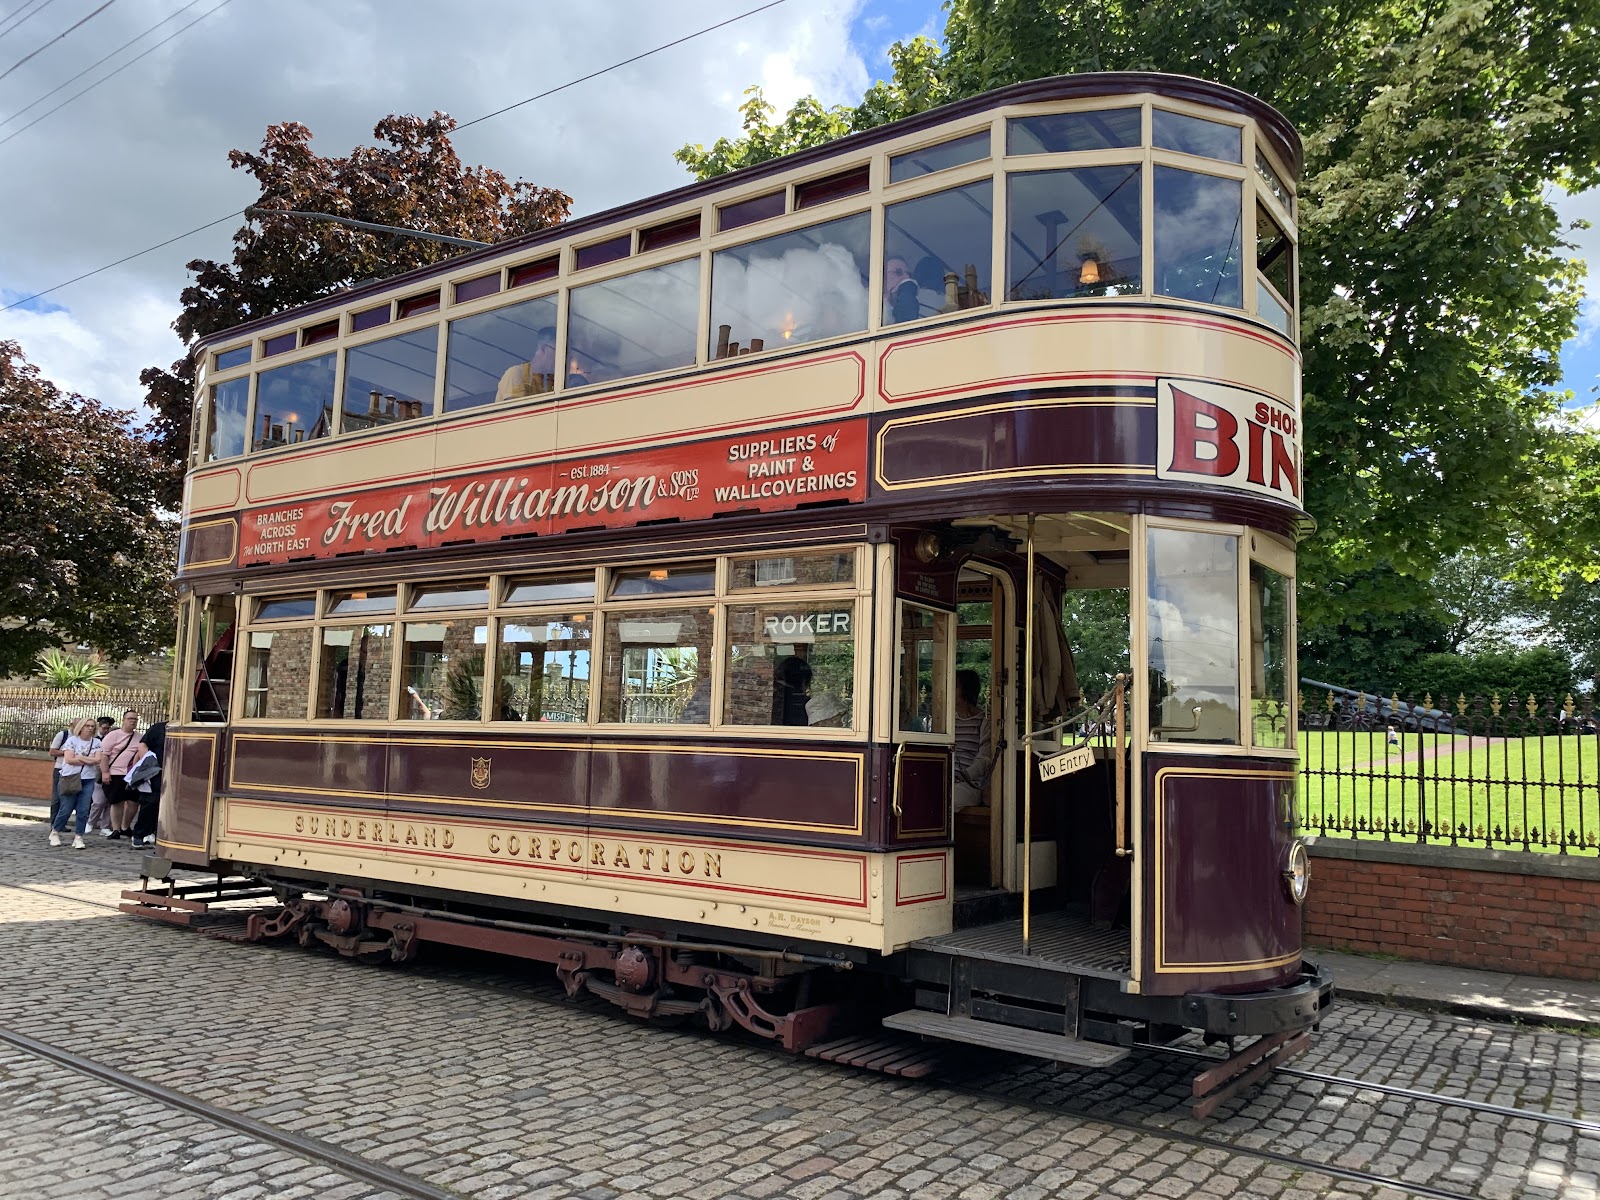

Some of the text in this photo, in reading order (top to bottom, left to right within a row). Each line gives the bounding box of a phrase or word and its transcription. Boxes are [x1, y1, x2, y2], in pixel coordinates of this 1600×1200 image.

[729, 429, 840, 461] SUPPLIERS of
[1166, 383, 1303, 503] BIN
[748, 455, 815, 478] PAINT &
[714, 470, 857, 502] WALLCOVERINGS
[257, 508, 304, 526] BRANCHES
[323, 494, 413, 545] Fred
[426, 475, 656, 533] Williamson
[657, 478, 669, 497] &
[260, 524, 297, 540] ACROSS
[254, 540, 284, 555] NORTH
[286, 537, 311, 551] EAST
[763, 612, 850, 635] ROKER
[1042, 752, 1090, 778] No Entry
[294, 815, 722, 878] SUNDERLAND CORPORATION
